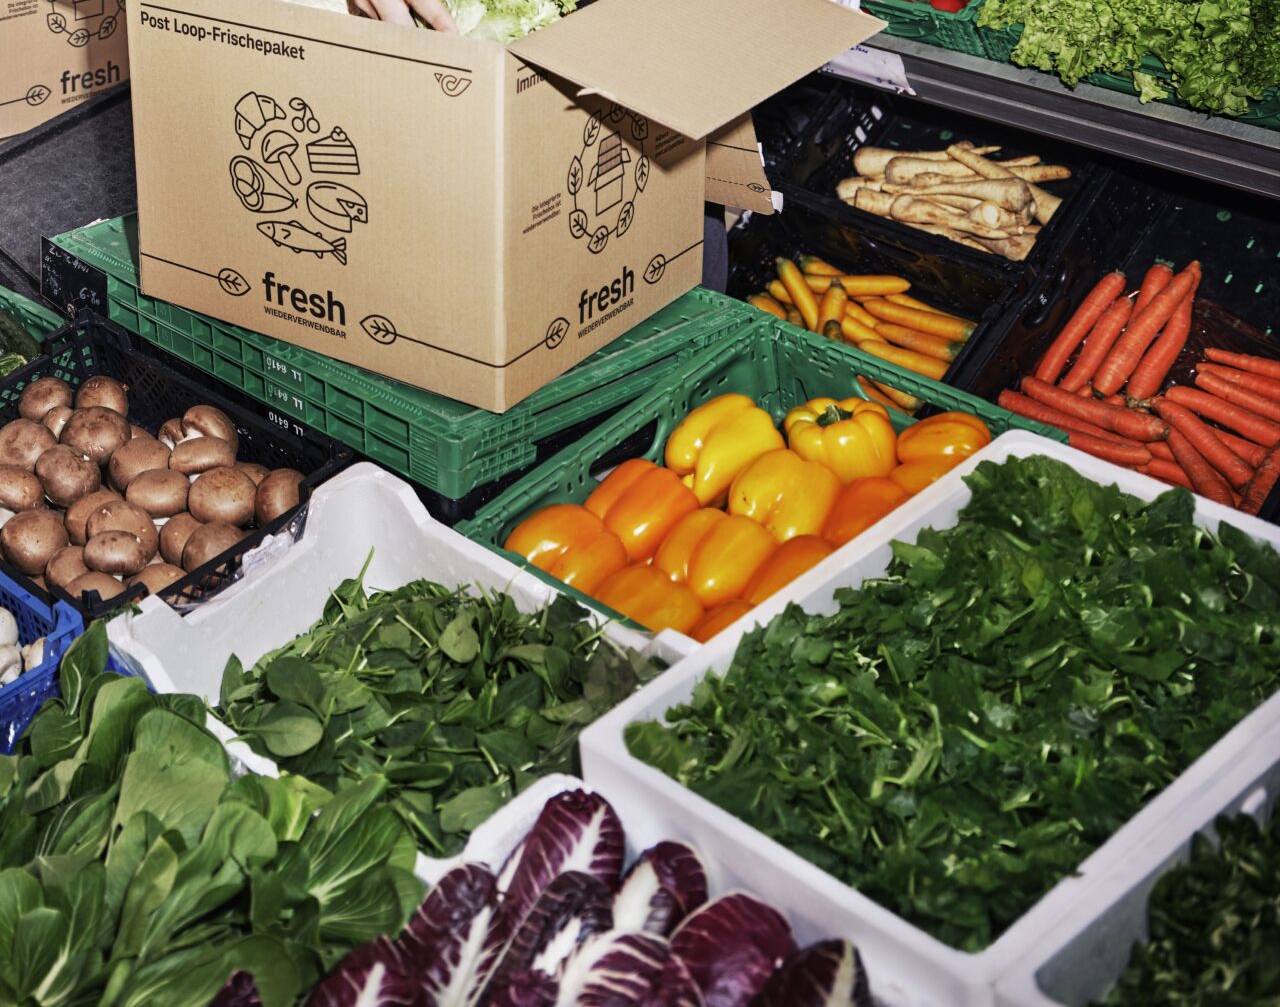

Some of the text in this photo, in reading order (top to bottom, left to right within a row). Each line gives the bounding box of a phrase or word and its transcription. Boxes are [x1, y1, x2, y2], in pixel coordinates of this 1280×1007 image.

[140, 11, 305, 60] Post Loop-Frischepaket
[61, 61, 120, 94] fresh
[262, 272, 345, 326] fresh
[578, 266, 634, 324] fresh
[264, 306, 346, 339] WIEDERVERWENDBAR
[577, 298, 634, 339] WIEDERVERWENDBAR
[291, 369, 302, 382] LL
[292, 396, 303, 410] LL
[268, 411, 304, 436] LL 6410
